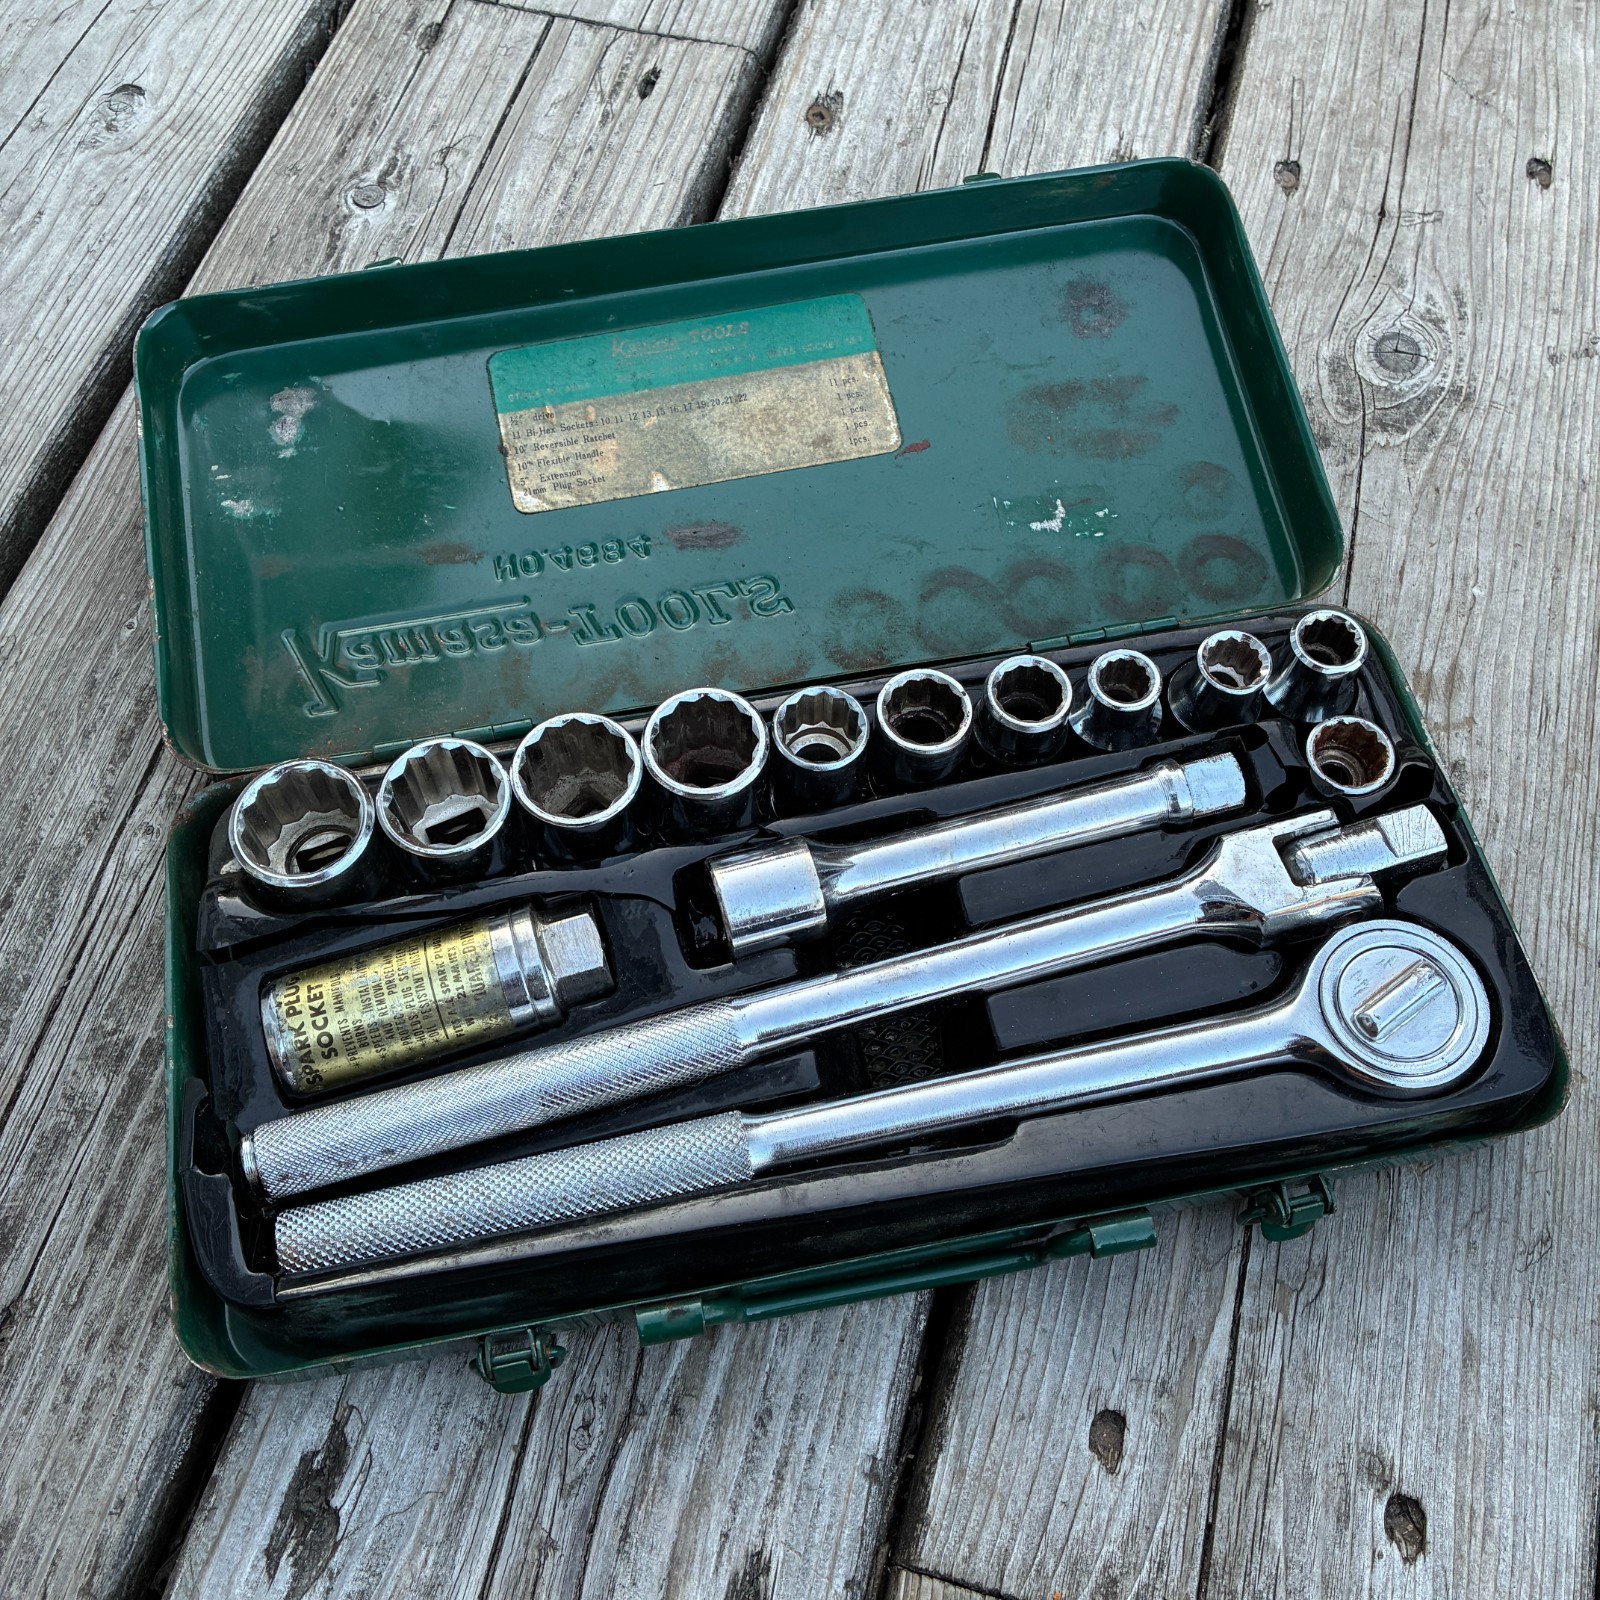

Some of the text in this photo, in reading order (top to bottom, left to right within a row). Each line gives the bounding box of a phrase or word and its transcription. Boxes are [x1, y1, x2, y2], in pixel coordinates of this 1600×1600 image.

[842, 376, 859, 387] pcs.
[846, 391, 863, 401] pcs.
[532, 412, 555, 422] drive
[850, 406, 867, 415] pcs.
[512, 430, 520, 440] 11
[526, 426, 556, 437] Bi-Hex
[854, 420, 871, 430] pcs.
[534, 438, 579, 452] Reversible
[583, 432, 616, 443] Ratchet
[536, 455, 571, 468] Flexible
[575, 450, 604, 461] Handle
[539, 469, 582, 483] Extension
[553, 480, 573, 492] Plug
[576, 475, 606, 487] Socket
[435, 961, 451, 995] SPARK
[401, 986, 416, 1010] PLUG
[412, 972, 434, 1021] RESISTANT
[455, 985, 467, 999] 21
[284, 976, 323, 1085] SPARK PLUG
[306, 983, 338, 1060] SOCKET
[408, 1014, 426, 1043] HOLDS
[451, 1019, 465, 1038] FITS
[351, 1018, 370, 1049] BURNS
[382, 1022, 396, 1040] AND
[426, 1024, 440, 1038] OIL
